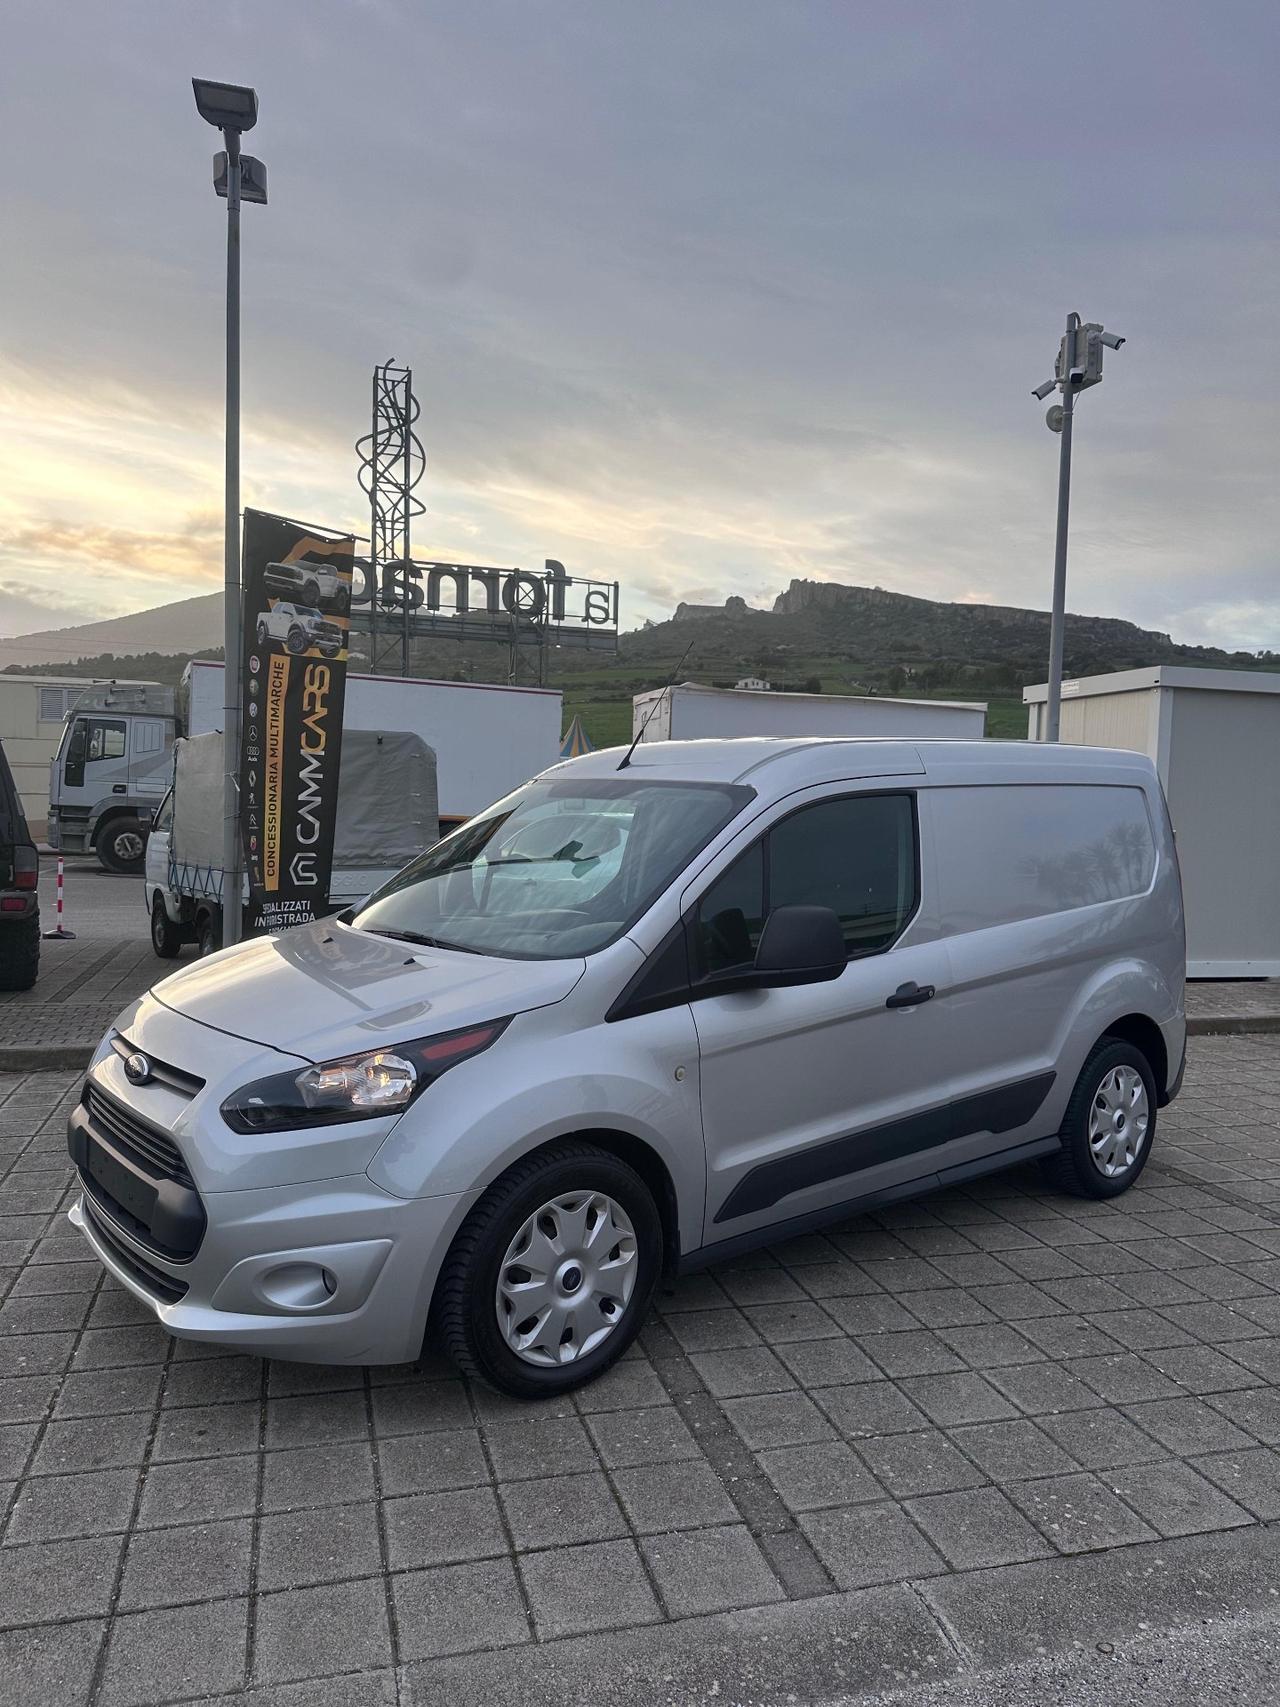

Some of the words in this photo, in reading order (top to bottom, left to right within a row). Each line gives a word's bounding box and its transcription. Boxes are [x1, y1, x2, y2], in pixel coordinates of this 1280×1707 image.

[269, 661, 285, 758] MULTIMARCHE
[296, 664, 331, 845] CAMMCARS
[266, 762, 278, 877] CONCESSIONARIA
[262, 900, 311, 914] SALIZZATI
